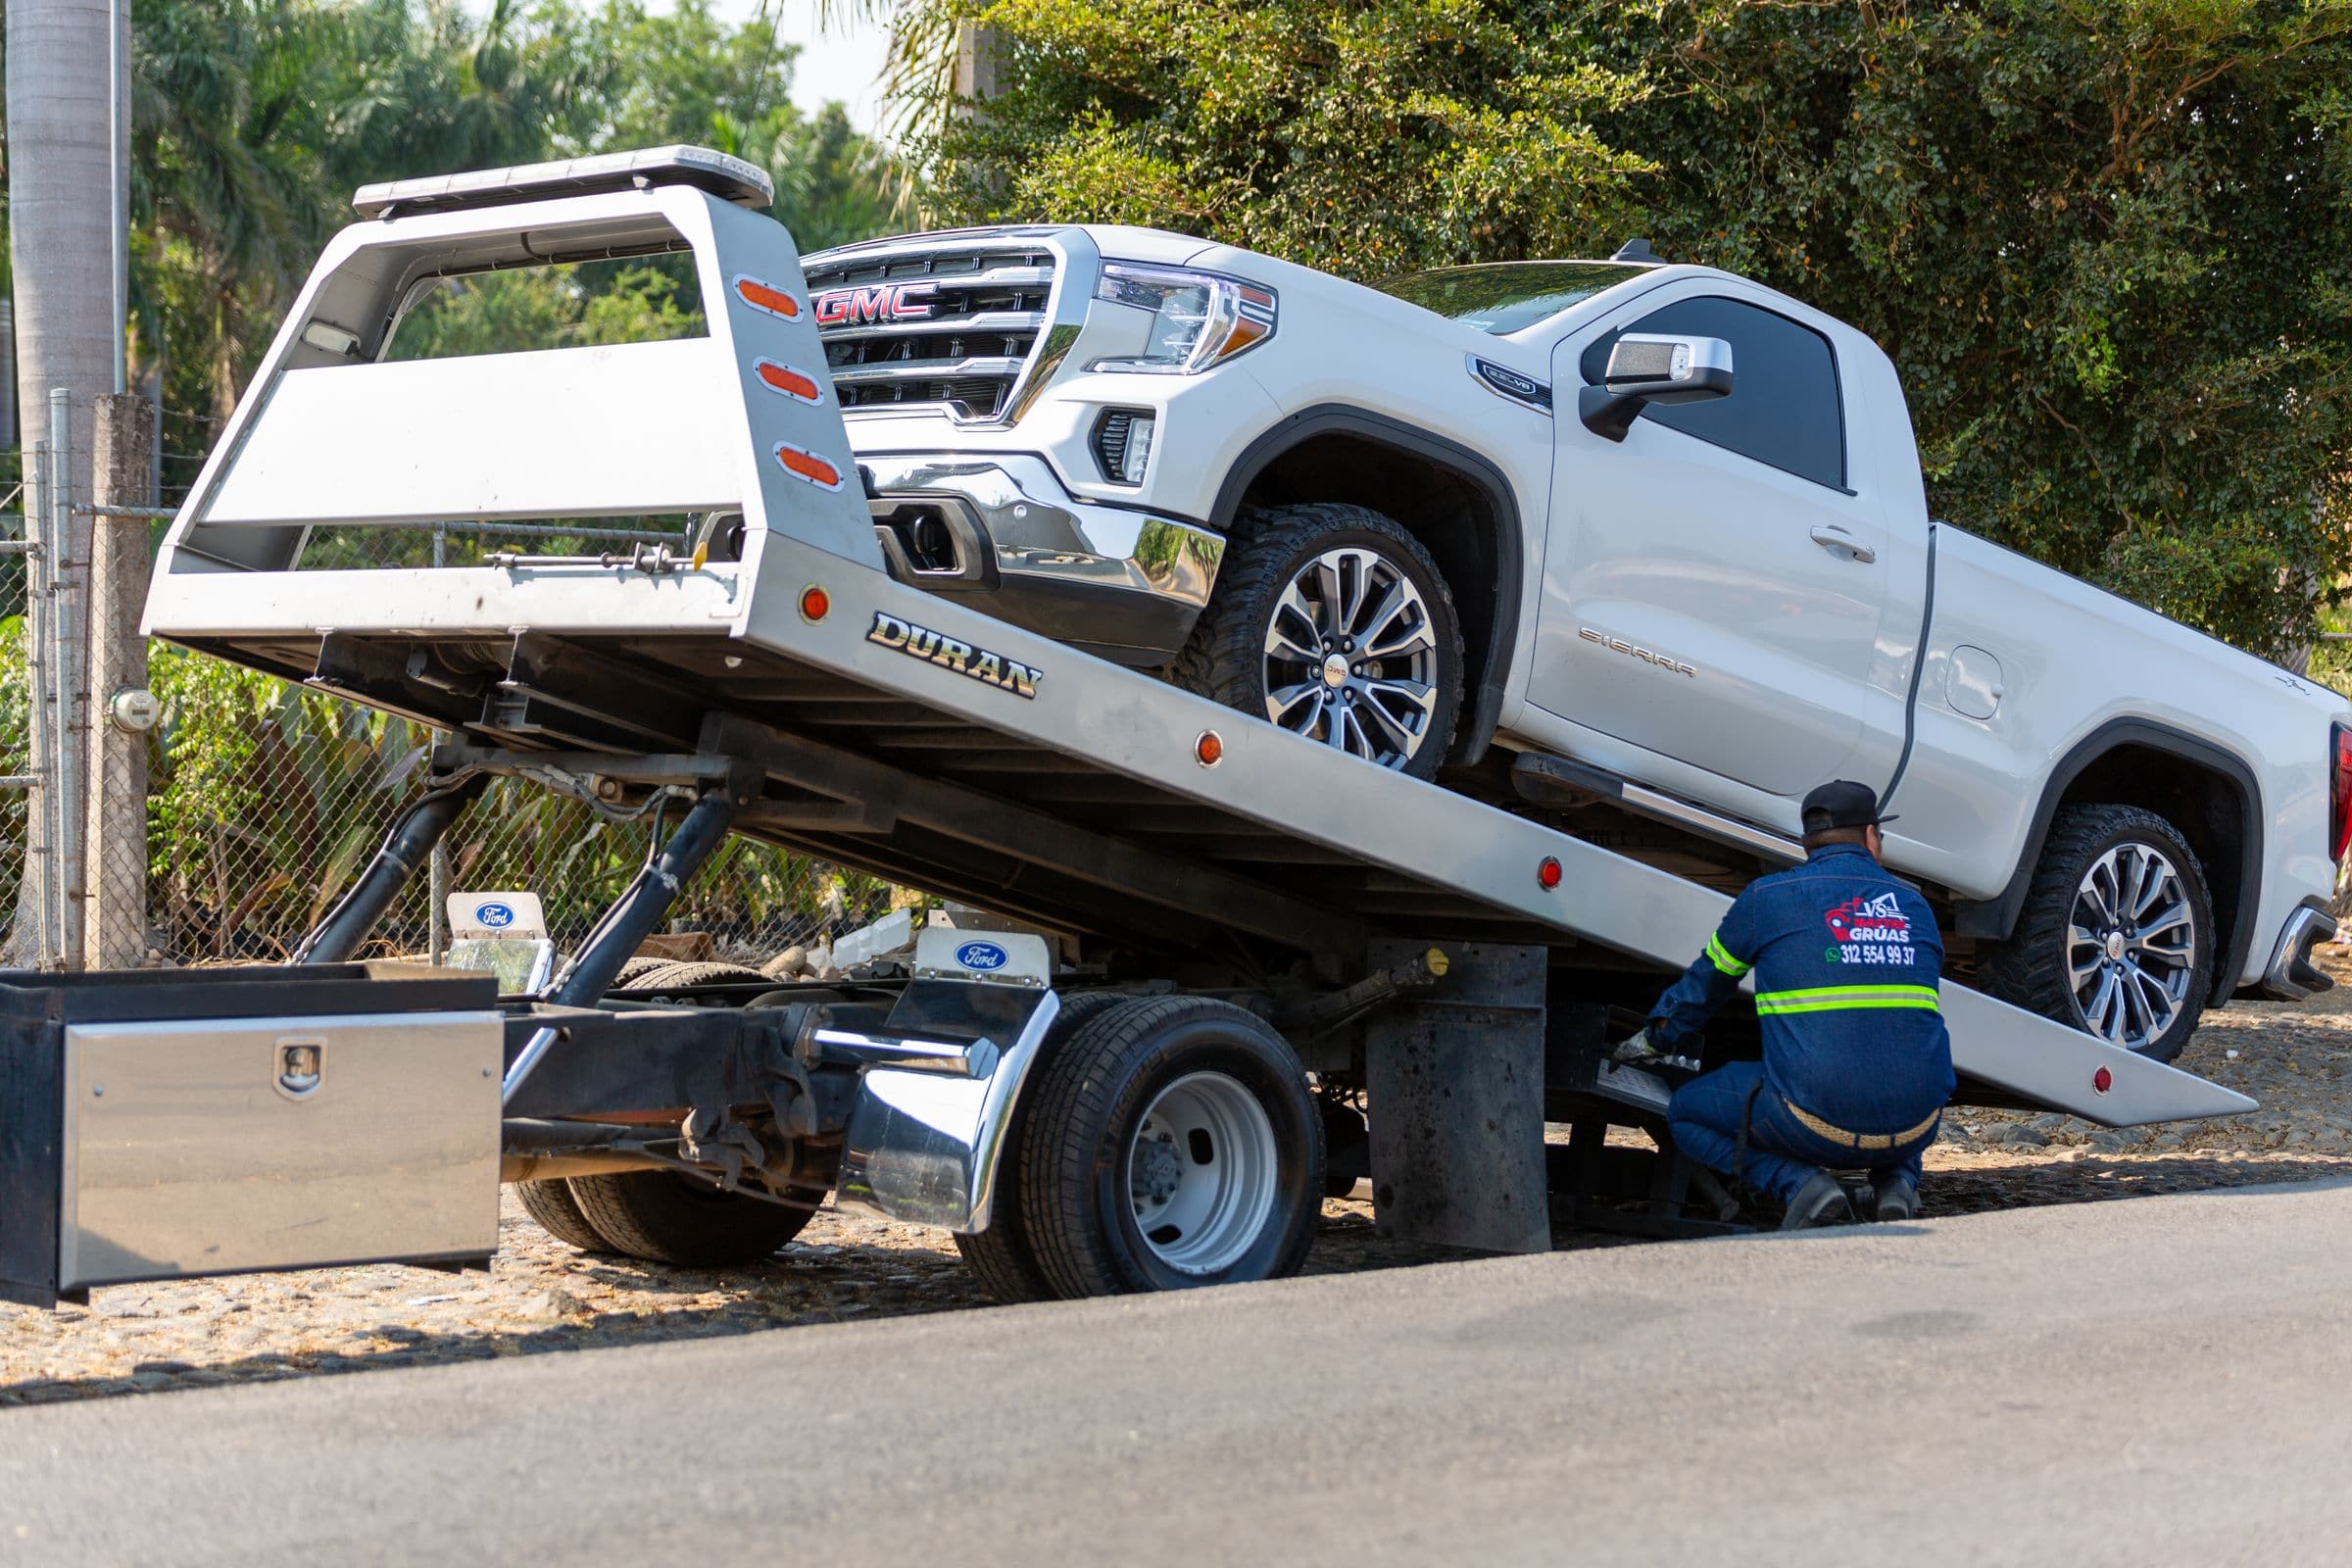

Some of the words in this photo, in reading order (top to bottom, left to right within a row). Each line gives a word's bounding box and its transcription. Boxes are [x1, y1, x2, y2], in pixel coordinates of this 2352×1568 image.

[816, 284, 939, 324] GMC
[866, 611, 1043, 699] DURAN
[1579, 627, 1697, 677] SIERRA
[483, 906, 508, 924] Ford
[1864, 902, 1887, 918] VS
[1849, 925, 1910, 943] GRÚAS
[964, 946, 999, 966] Ford
[1840, 944, 1861, 963] 312
[1863, 945, 1886, 964] 554
[1886, 945, 1901, 964] 99
[1902, 947, 1915, 965] 37
